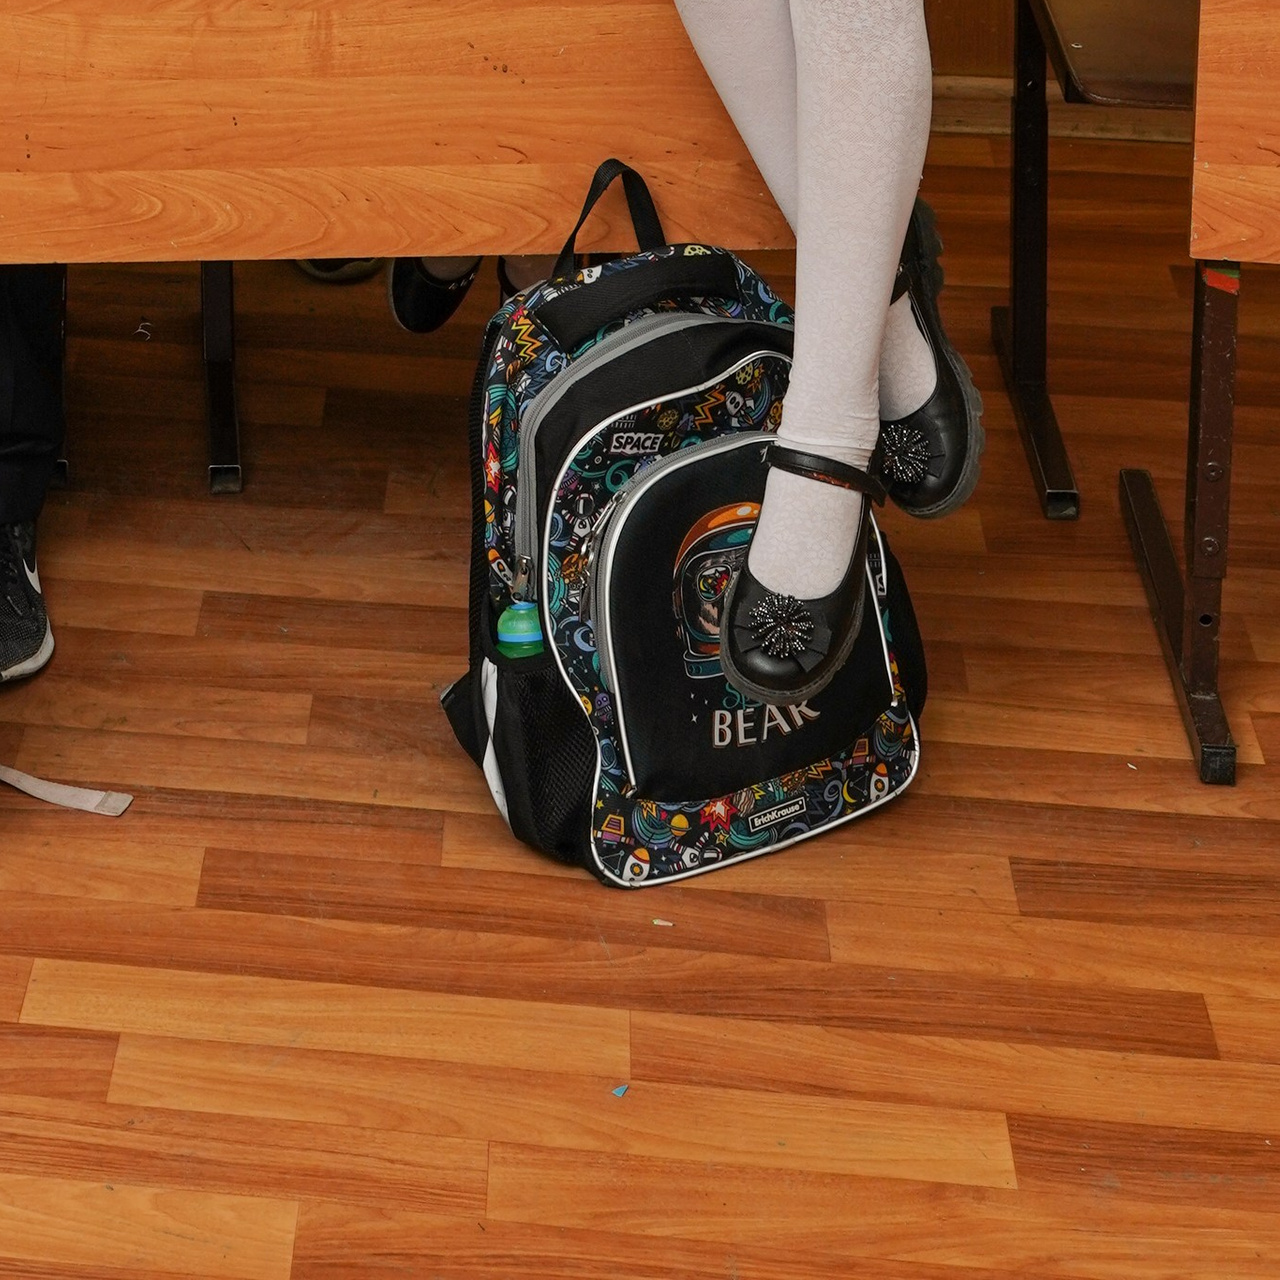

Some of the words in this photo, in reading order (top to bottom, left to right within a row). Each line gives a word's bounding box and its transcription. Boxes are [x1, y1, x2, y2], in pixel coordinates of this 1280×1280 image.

[613, 435, 659, 451] SPACE
[712, 700, 820, 748] BEAR
[753, 804, 800, 827] ErichKrause
